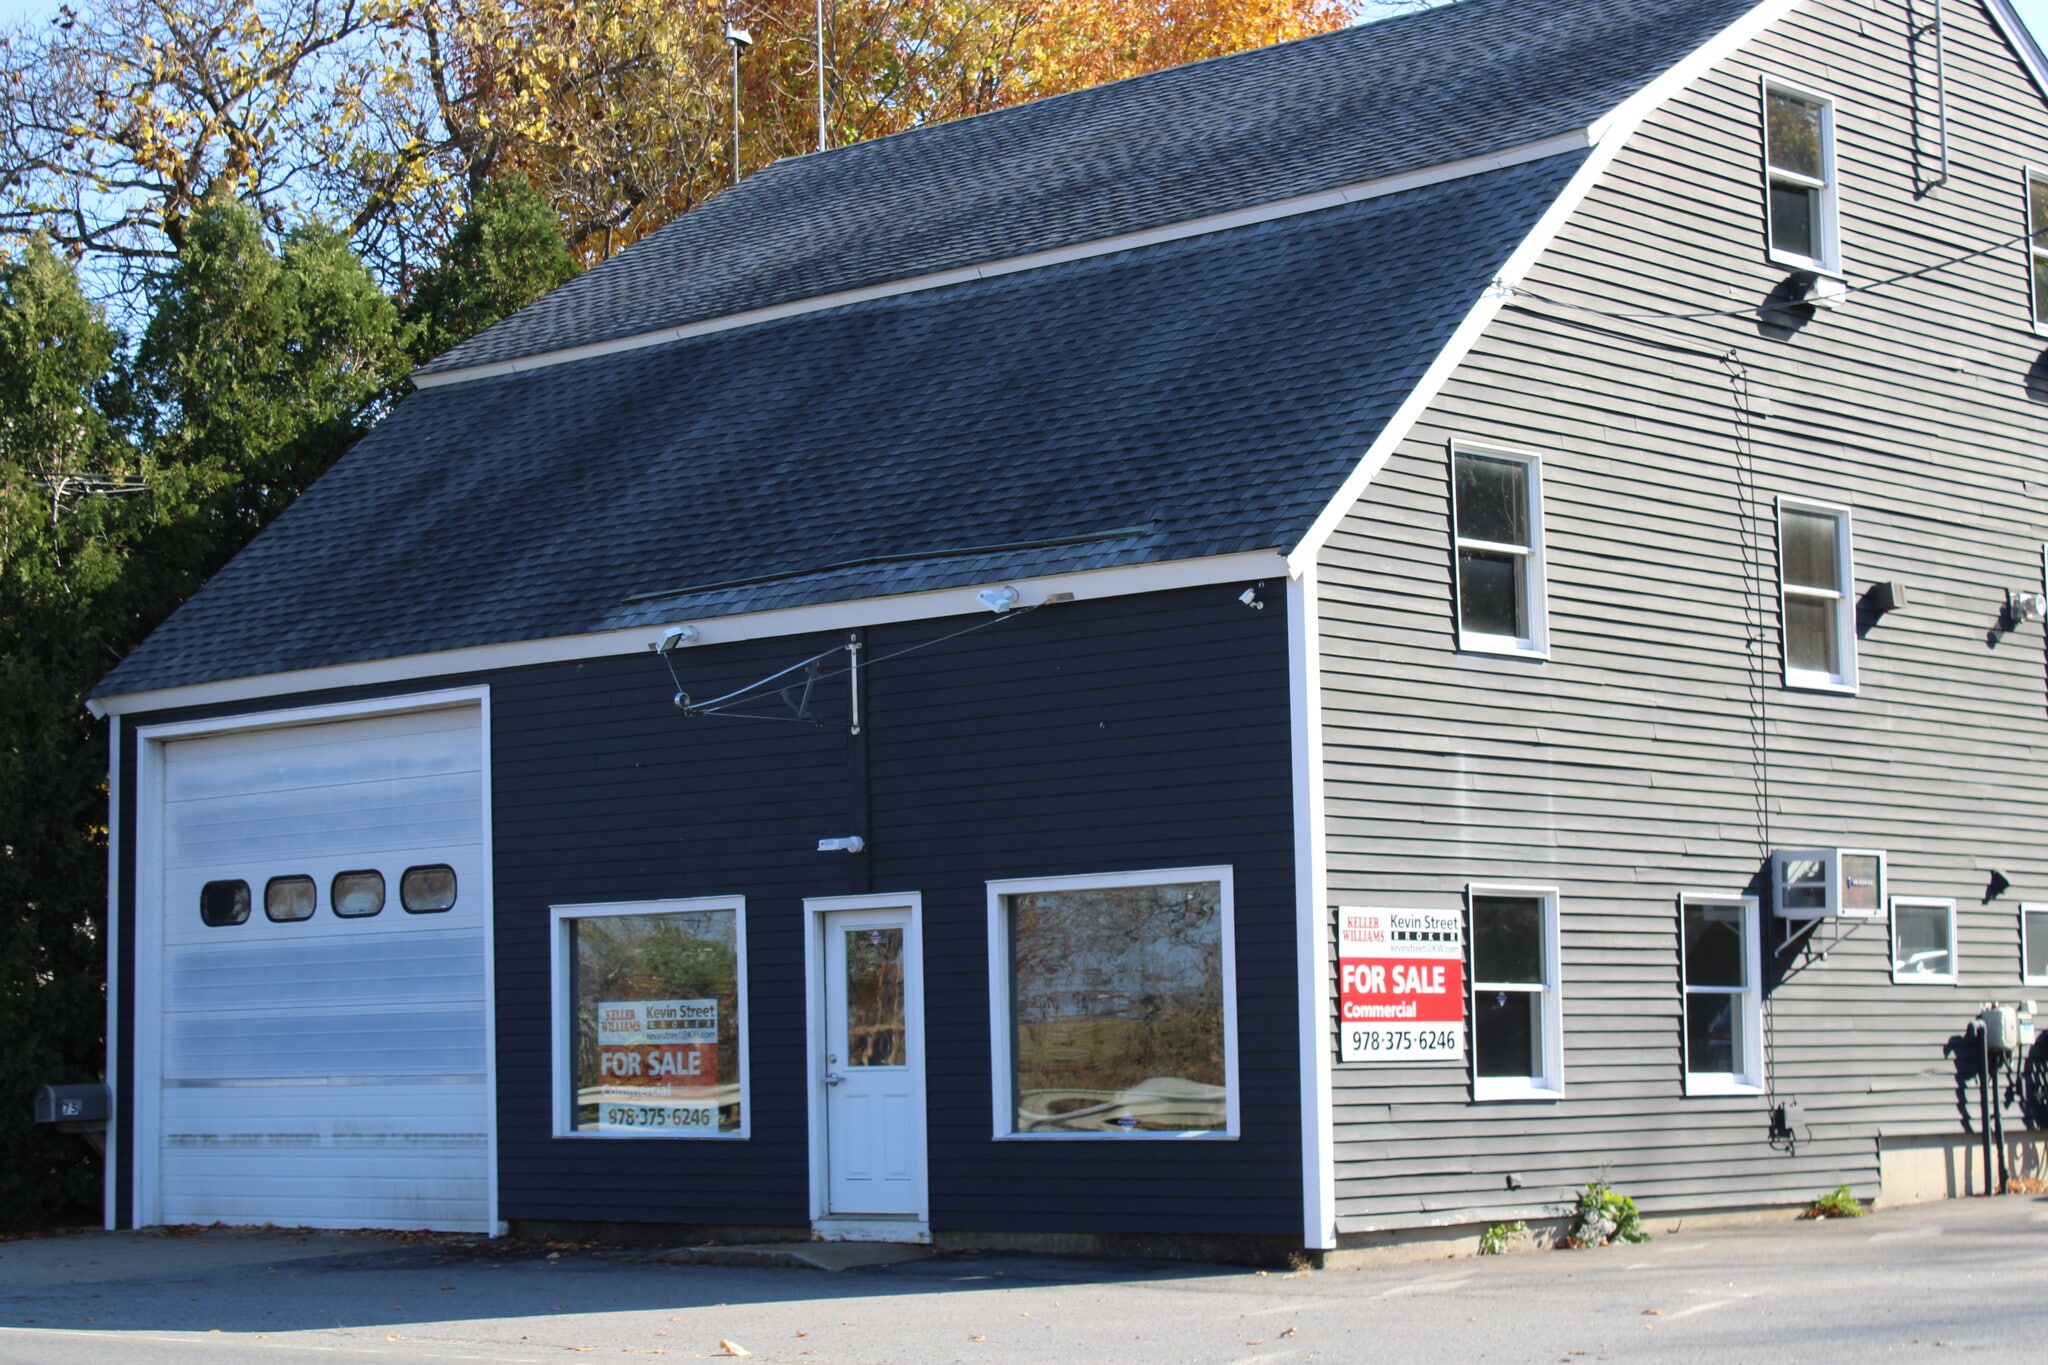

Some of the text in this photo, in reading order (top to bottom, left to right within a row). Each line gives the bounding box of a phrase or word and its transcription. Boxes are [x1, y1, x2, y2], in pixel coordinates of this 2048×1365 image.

[1347, 916, 1379, 928] KELLER
[1390, 914, 1458, 930] Kevin Street
[1343, 930, 1384, 942] WILLIAMS
[1393, 931, 1456, 941] BROKER
[1342, 964, 1446, 994] FOR SALE
[605, 1009, 636, 1021] KELLER
[646, 1004, 715, 1019] Kevin Street
[1343, 1001, 1417, 1018] Commercial
[600, 1021, 641, 1032] WILLIAMS
[601, 1051, 701, 1076] FOR SALE
[601, 1082, 672, 1097] Commercial
